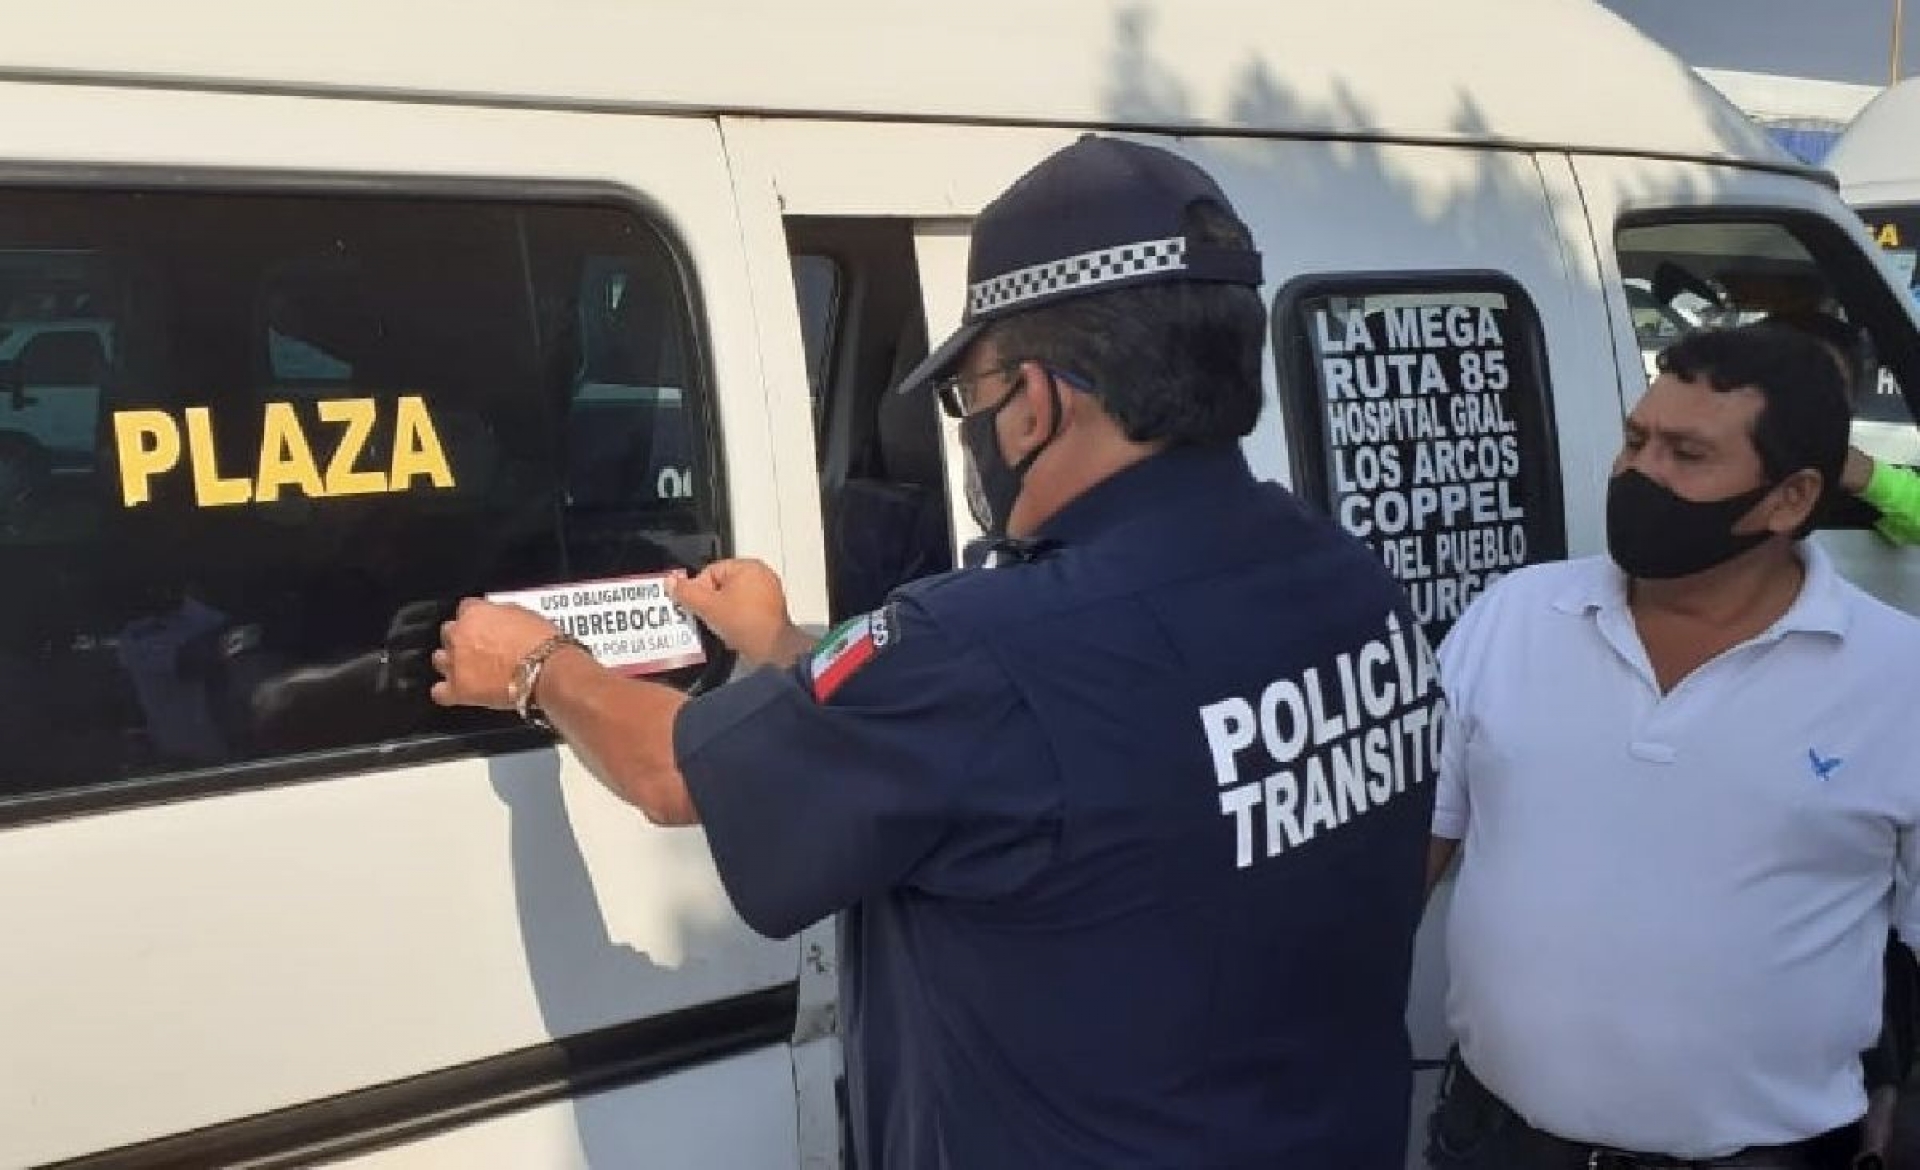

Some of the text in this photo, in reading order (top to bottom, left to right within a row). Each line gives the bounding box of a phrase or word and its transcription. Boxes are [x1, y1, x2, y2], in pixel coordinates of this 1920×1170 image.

[1316, 306, 1503, 351] LA MEGA
[1323, 351, 1509, 399] RUTA 85
[1328, 394, 1517, 446] HOSPITAL GRAL.
[114, 396, 455, 506] PLAZA
[1335, 436, 1519, 492] LOS ARCOS
[1340, 482, 1524, 537] COPPEL
[1383, 525, 1526, 579] DEL PUEBLO
[541, 594, 569, 611] USO
[573, 584, 660, 607] OBLIGATORIO
[552, 603, 688, 637] UBREBOCAS
